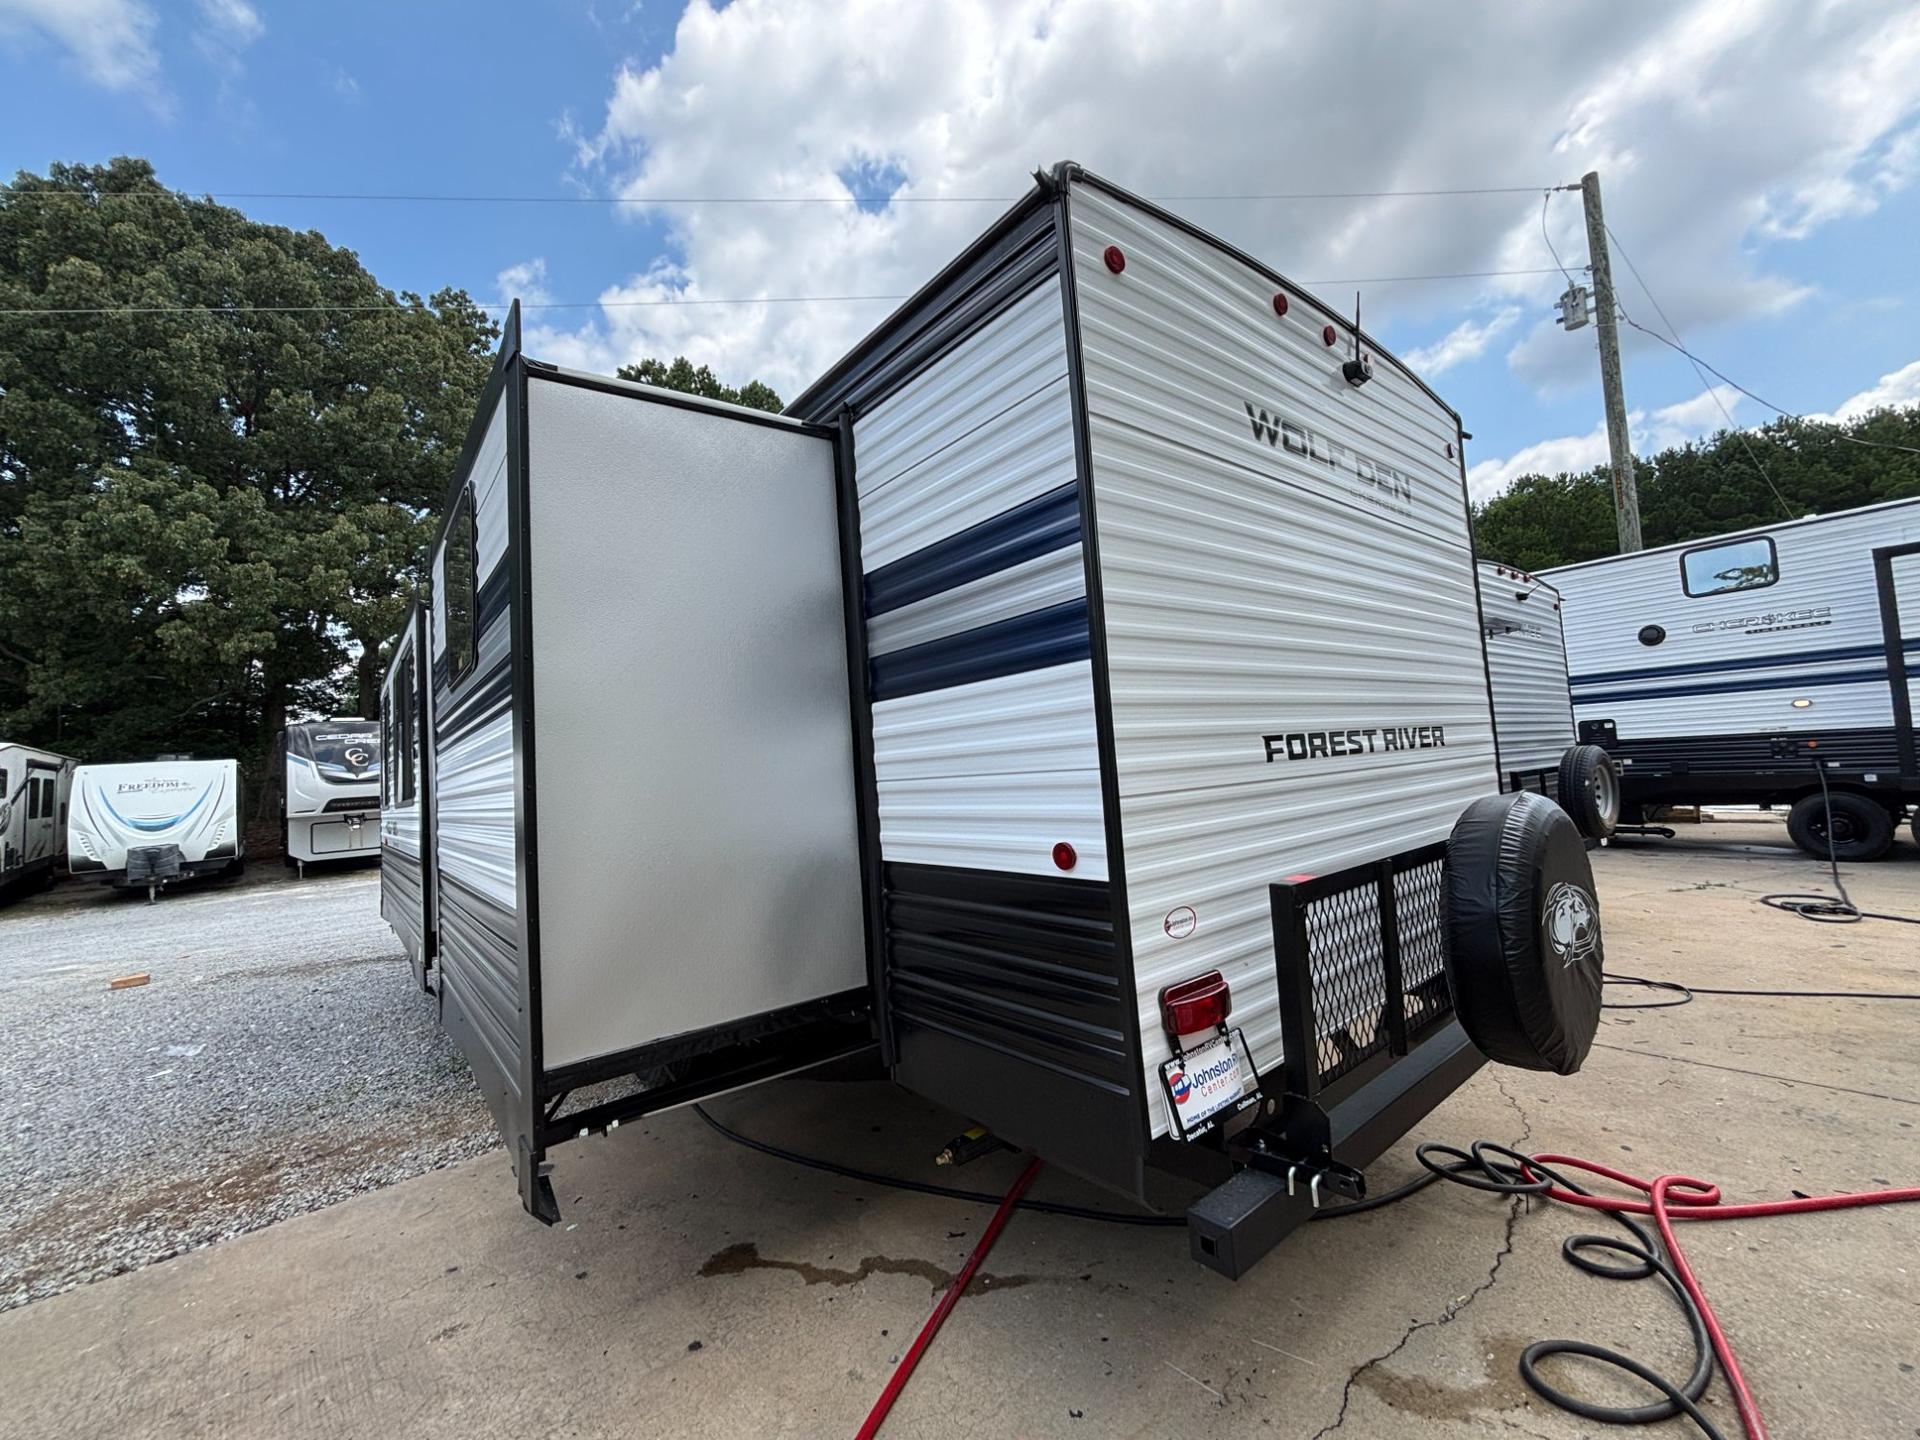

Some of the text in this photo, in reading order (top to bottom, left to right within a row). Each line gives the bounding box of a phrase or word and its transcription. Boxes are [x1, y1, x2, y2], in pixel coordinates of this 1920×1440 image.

[1262, 726, 1446, 763] FOREST RIVER
[118, 782, 179, 791] FREEDOM
[1192, 1057, 1233, 1089] Johnston
